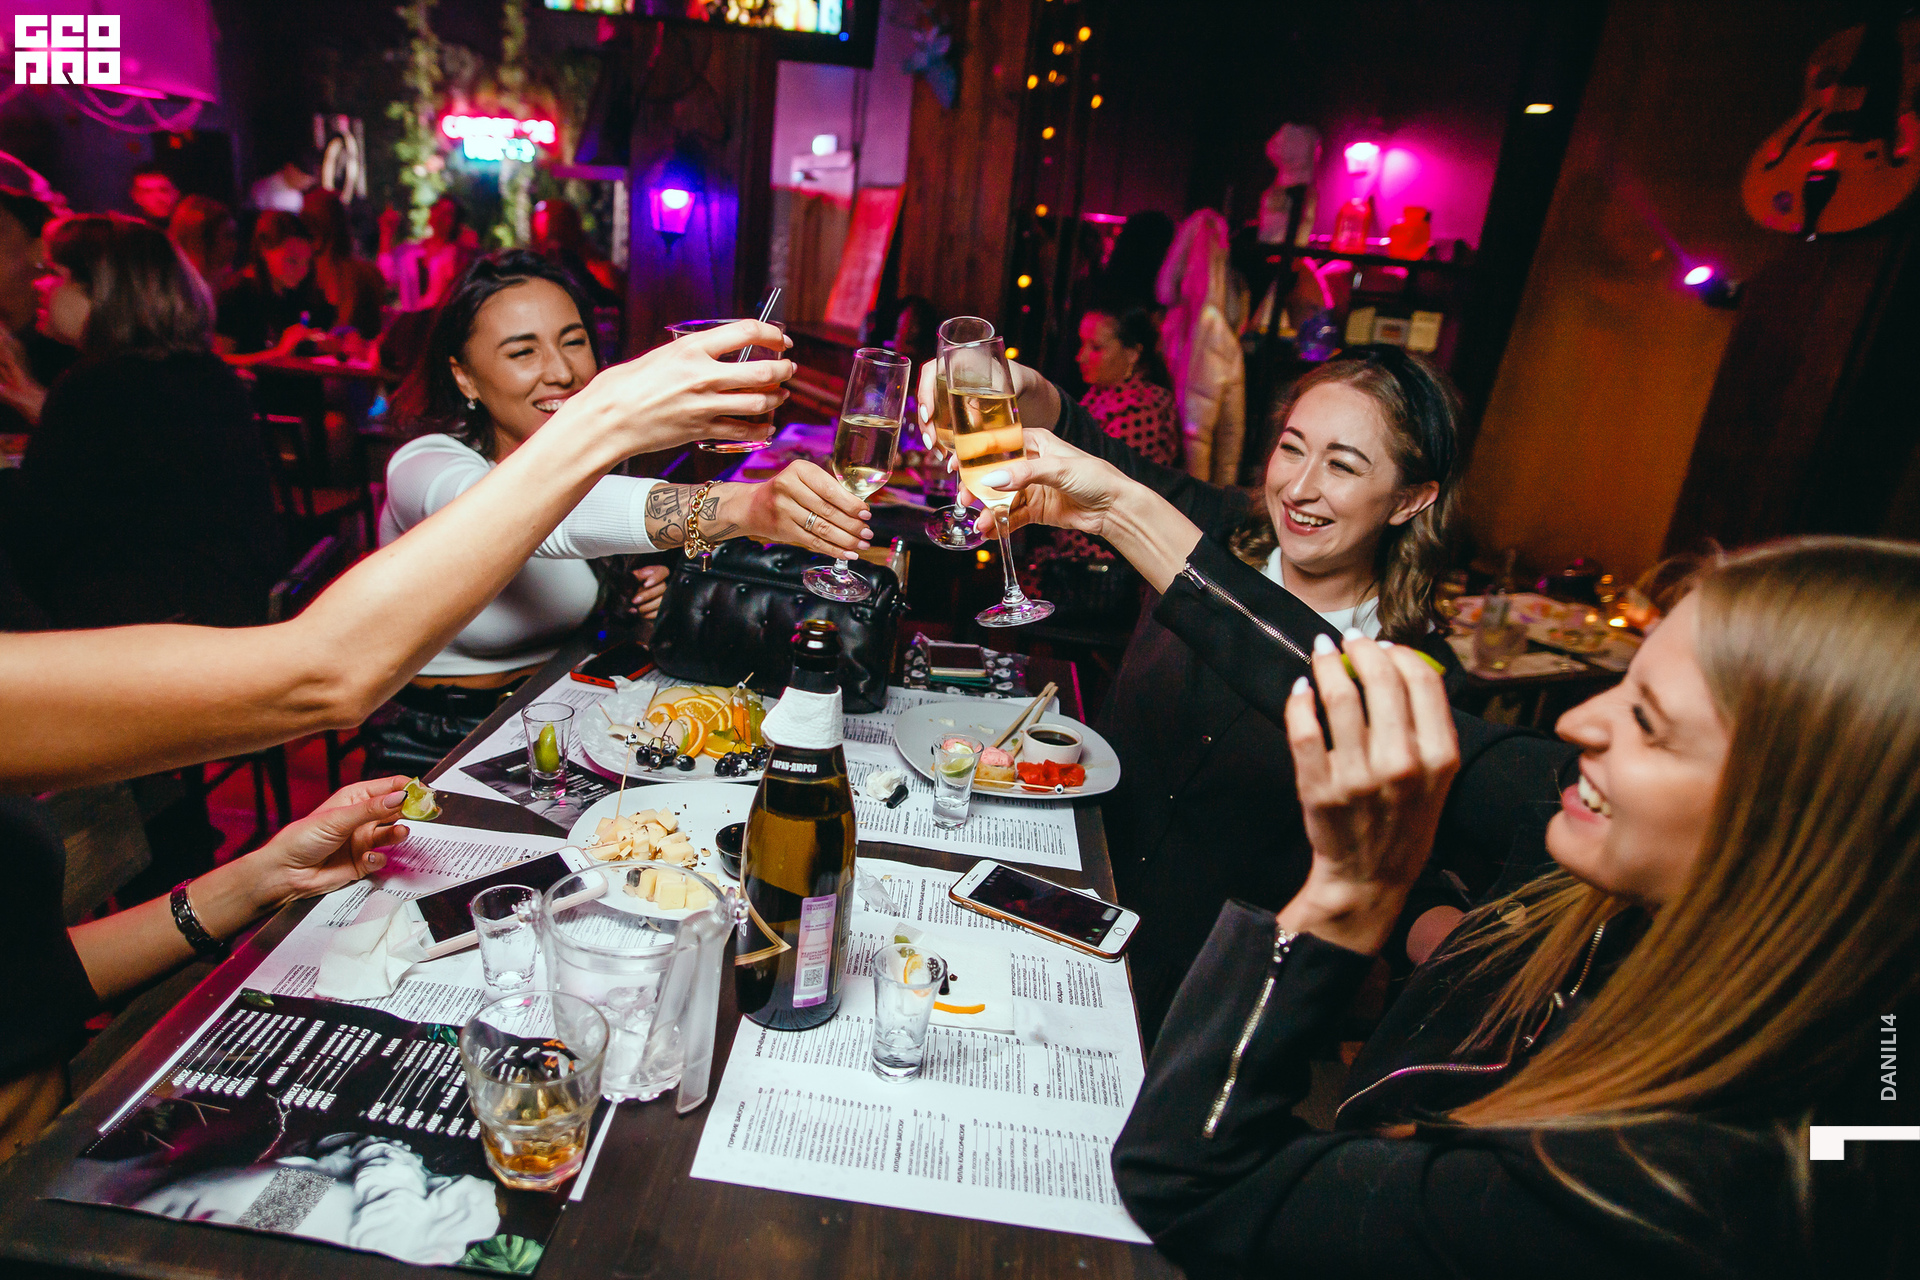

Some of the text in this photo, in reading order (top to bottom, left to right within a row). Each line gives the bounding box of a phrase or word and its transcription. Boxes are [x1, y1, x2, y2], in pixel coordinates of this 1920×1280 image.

[772, 760, 818, 774] АБРАУ-ДЮРСО
[268, 1020, 324, 1084] ШАМПАНСКОЕ, ВИНО
[381, 1038, 402, 1056] ШОТЫ
[728, 1101, 745, 1147] ГОРЯЧИЕ ЗАКУСКИ
[893, 1142, 901, 1172] ХОЛОДНЫЕ
